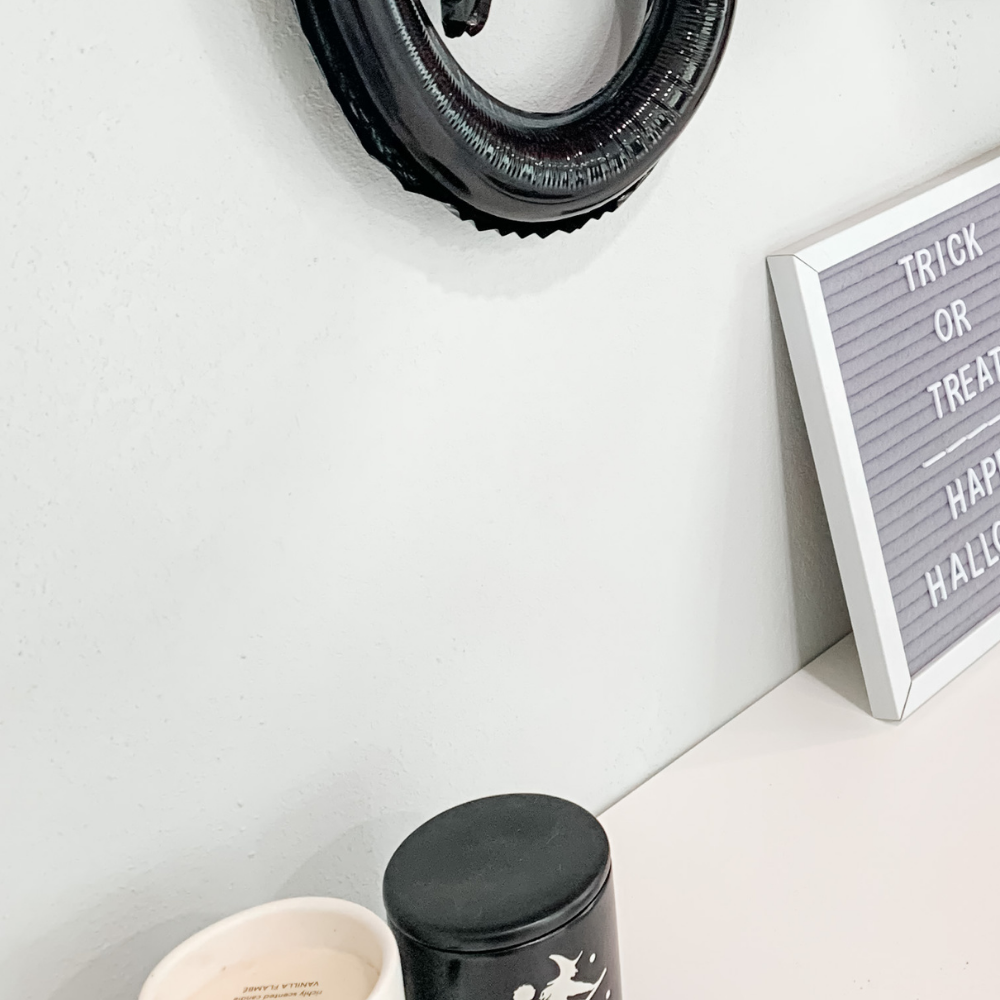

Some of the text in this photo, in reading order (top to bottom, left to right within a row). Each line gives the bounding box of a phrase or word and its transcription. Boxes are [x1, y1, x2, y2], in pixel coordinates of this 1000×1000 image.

[898, 222, 984, 292] TRICK
[933, 298, 972, 343] OR
[281, 980, 319, 989] VANILLA
[263, 988, 298, 1000] scented
[300, 985, 323, 997] richly
